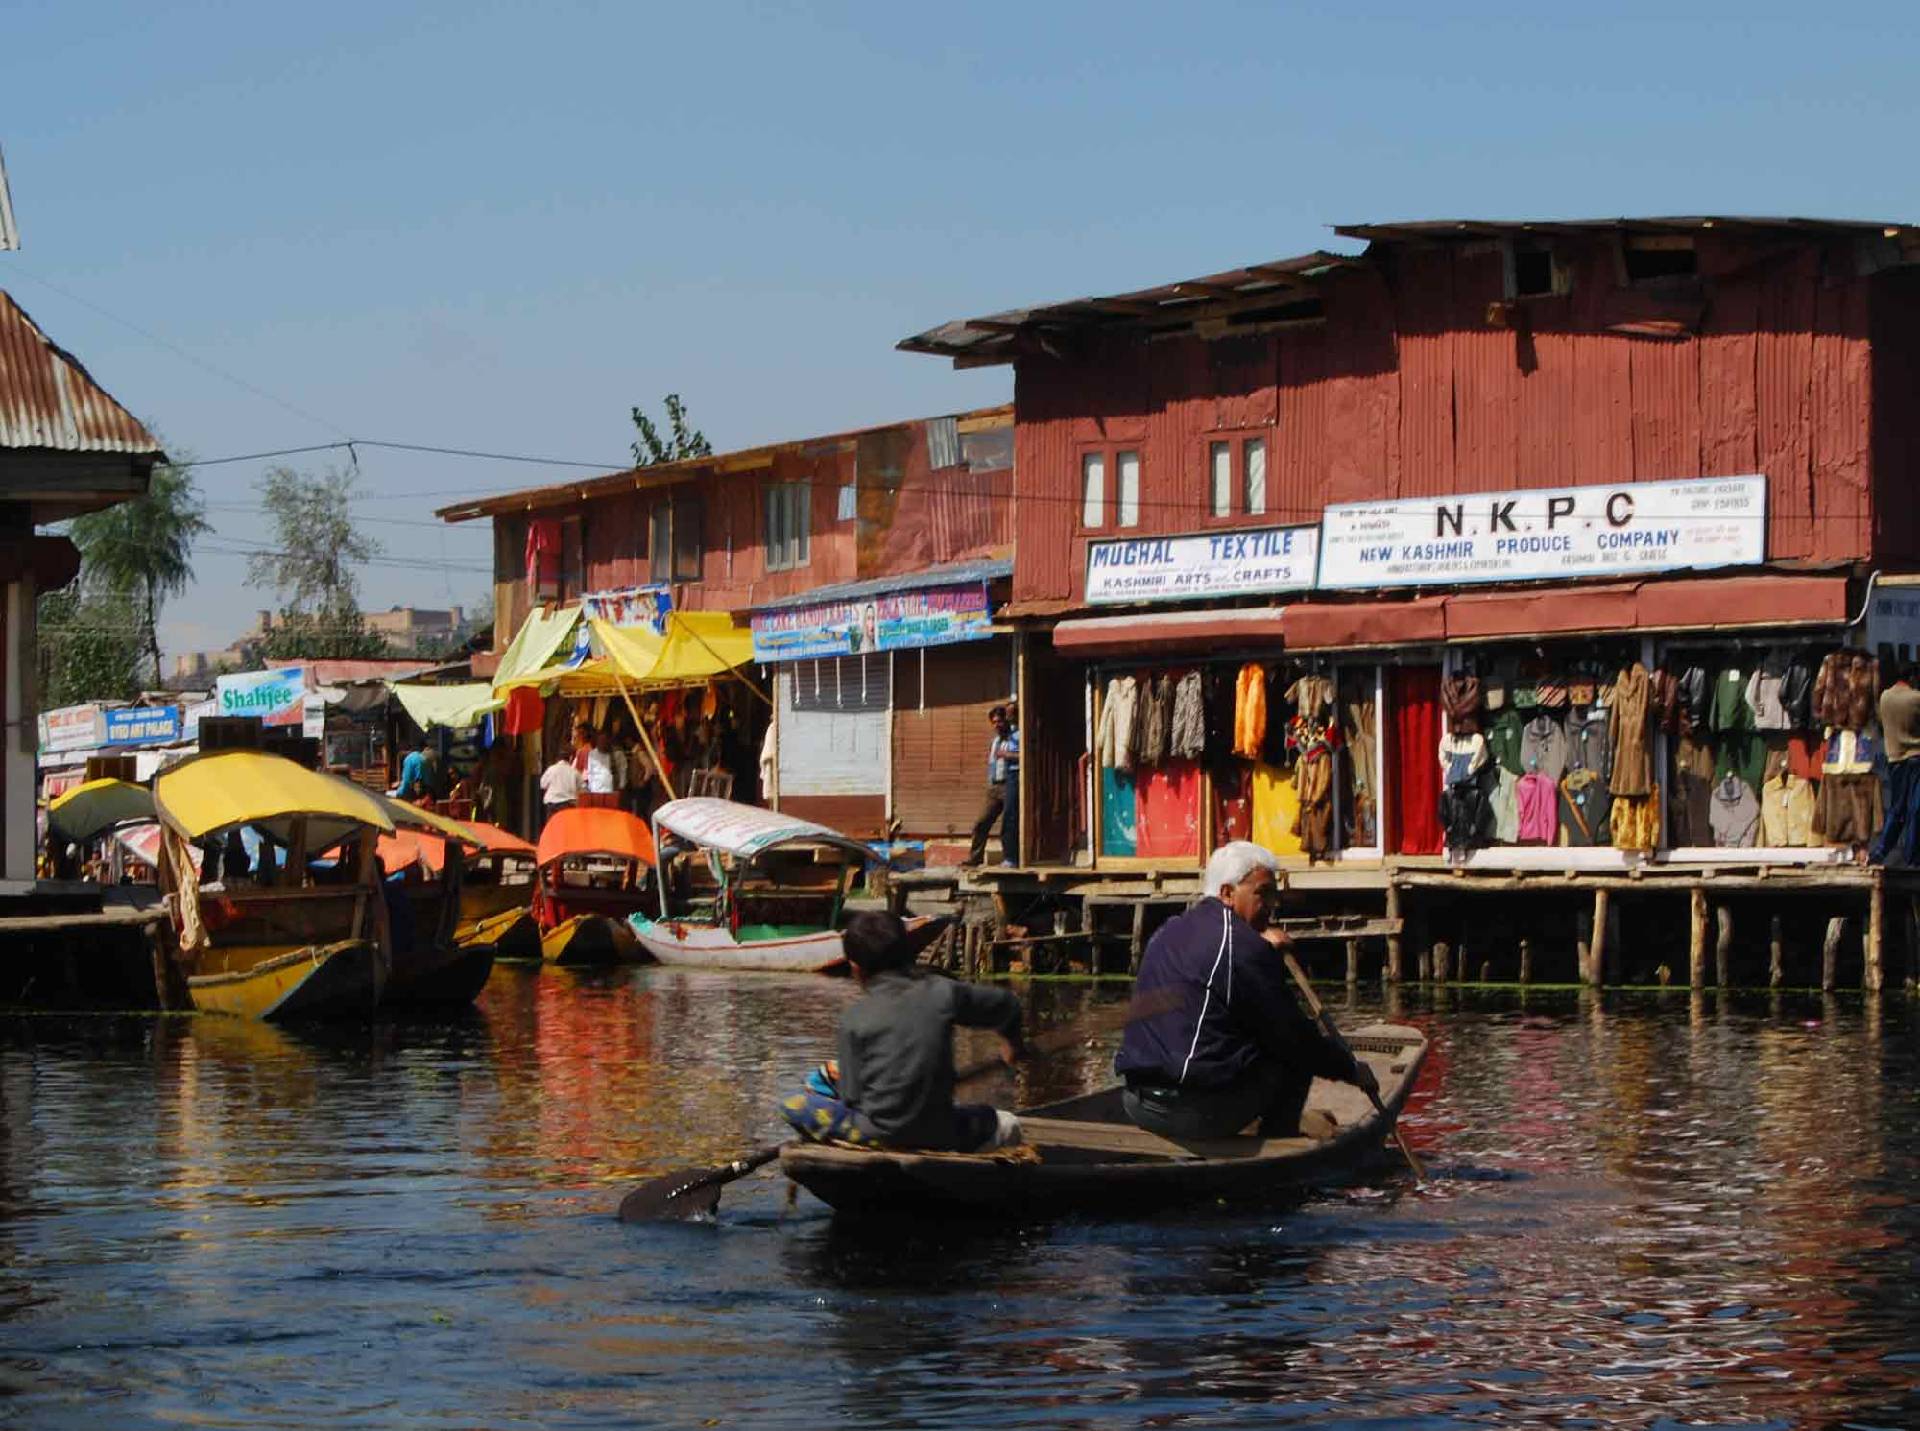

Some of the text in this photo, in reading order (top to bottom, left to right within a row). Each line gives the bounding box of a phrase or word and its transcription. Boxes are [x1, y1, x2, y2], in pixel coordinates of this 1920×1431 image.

[1093, 541, 1174, 567] MUGHAL
[1210, 530, 1293, 560] TEXTILE
[1359, 547, 1393, 562] NEW
[1402, 541, 1474, 560] KASHMIR
[1496, 535, 1571, 554] PRODUCE
[1597, 530, 1679, 549] COMPANY
[1174, 572, 1212, 585] ARTS
[1233, 567, 1292, 583] CRAFTS
